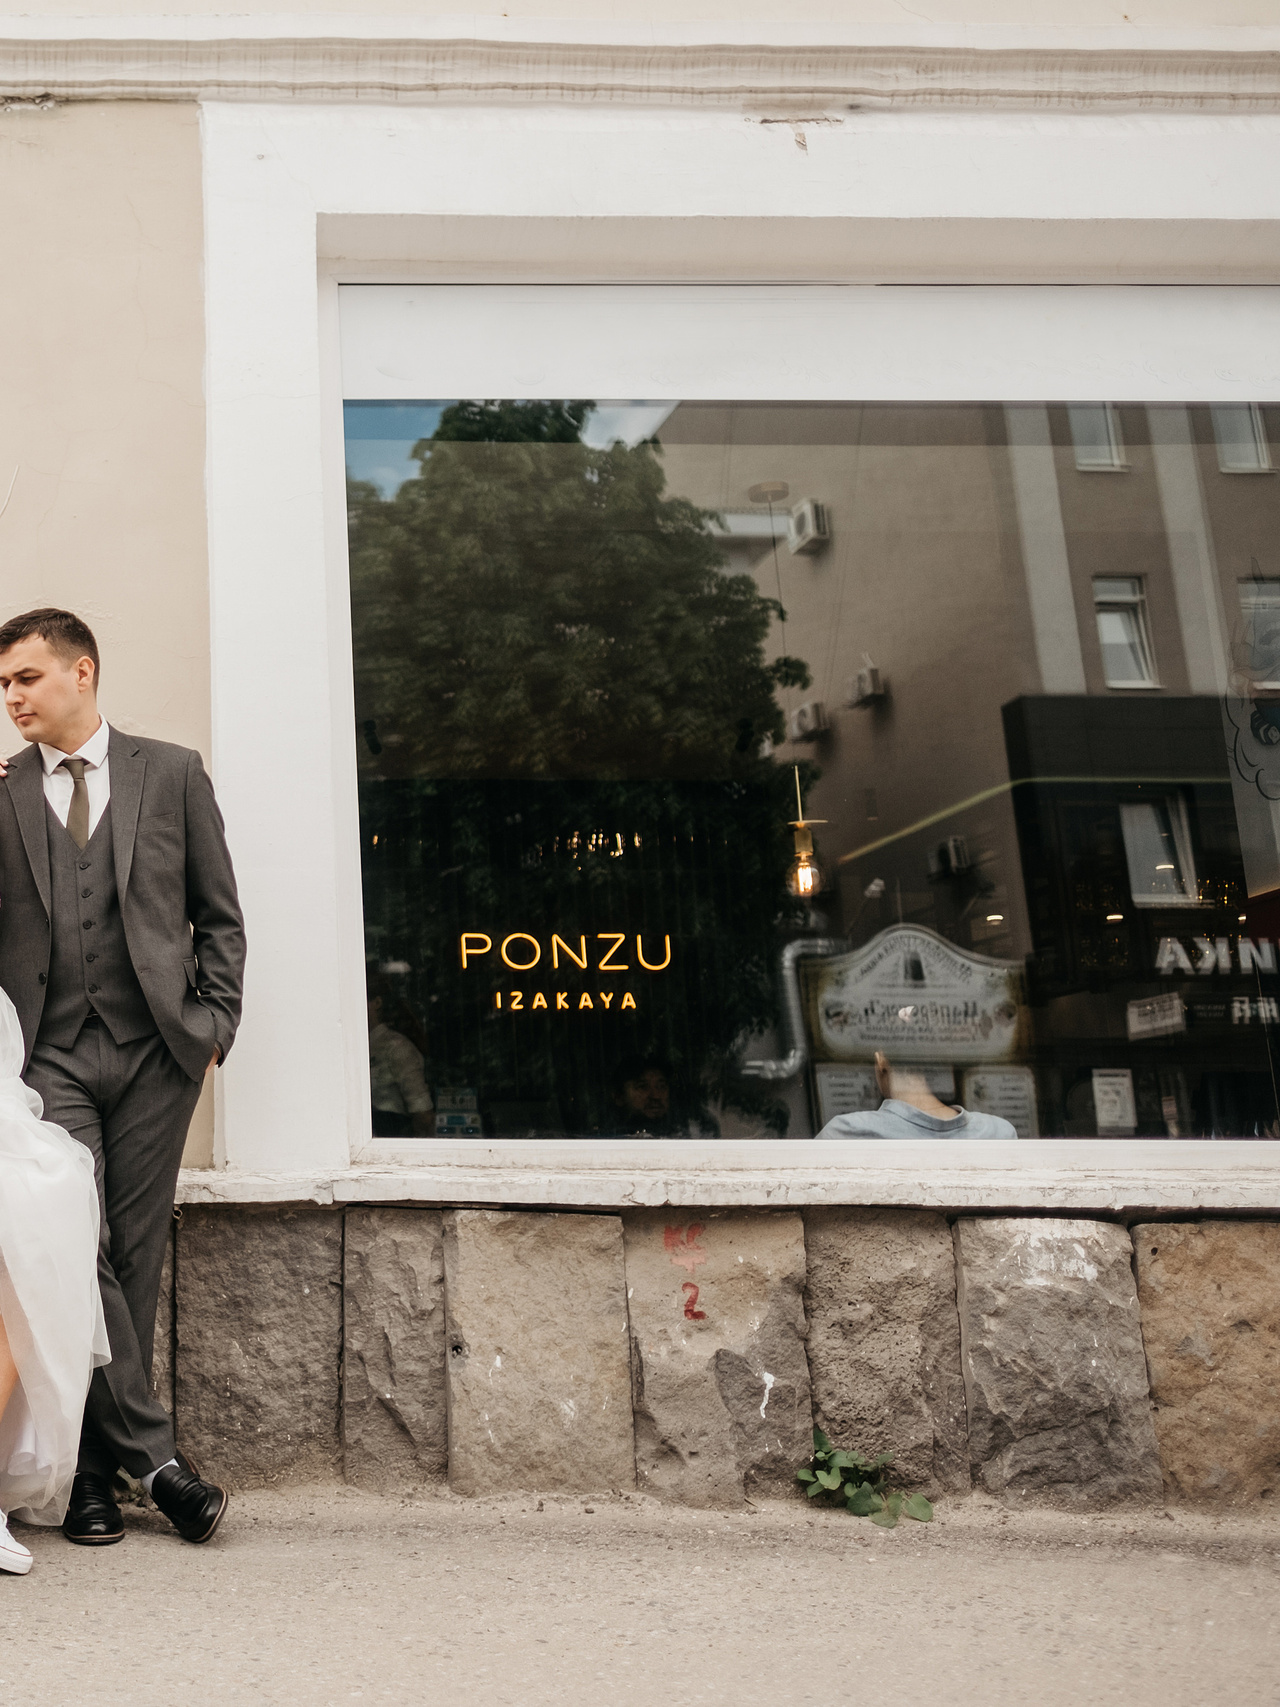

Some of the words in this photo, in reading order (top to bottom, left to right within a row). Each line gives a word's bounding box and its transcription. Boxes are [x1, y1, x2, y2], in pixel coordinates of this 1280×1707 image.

[461, 932, 671, 970] PONZU
[494, 991, 637, 1010] IZAKAYA
[682, 1282, 707, 1320] 2
